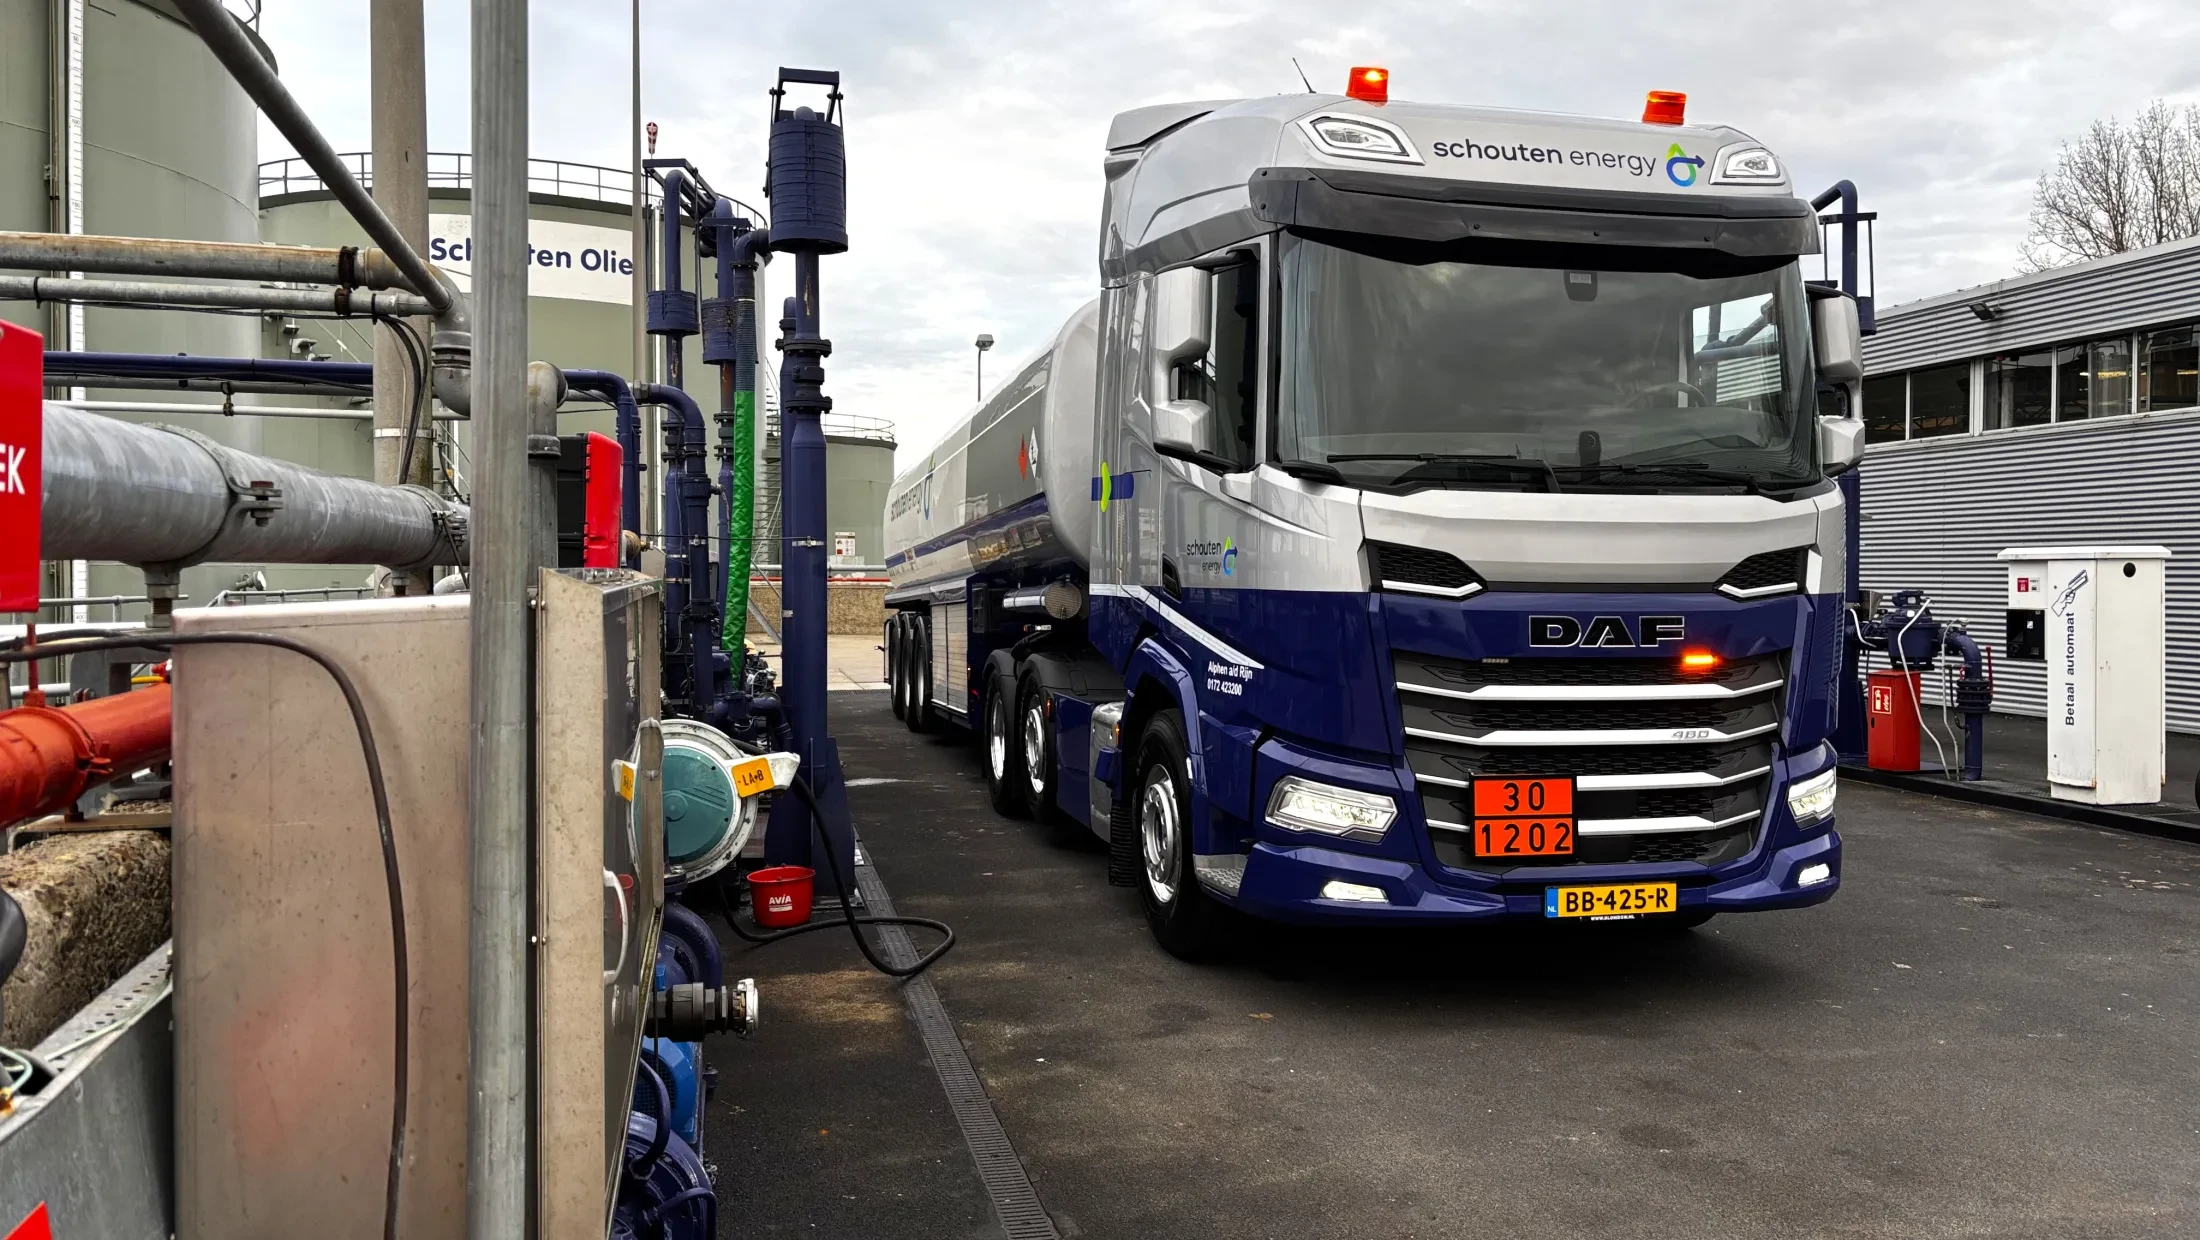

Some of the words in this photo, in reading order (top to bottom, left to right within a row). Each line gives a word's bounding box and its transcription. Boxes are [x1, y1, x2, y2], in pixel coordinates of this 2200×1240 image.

[1433, 138, 1563, 164] schouten
[1569, 150, 1657, 177] energy
[580, 248, 633, 276] Olie
[1186, 538, 1222, 556] schouten
[1202, 560, 1222, 574] energy
[1528, 615, 1685, 648] DAF
[2065, 612, 2075, 676] automaat
[1207, 660, 1228, 676] Alphen
[1228, 664, 1239, 677] a/d
[1239, 665, 1253, 682] Rijn
[1207, 677, 1221, 692] 0172
[2065, 682, 2075, 726] Betaal
[1671, 730, 1710, 739] 480
[1503, 782, 1545, 812] 30
[1481, 822, 1571, 854] 1202
[1547, 905, 1557, 913] NL
[1565, 887, 1669, 913] BB-425-R
